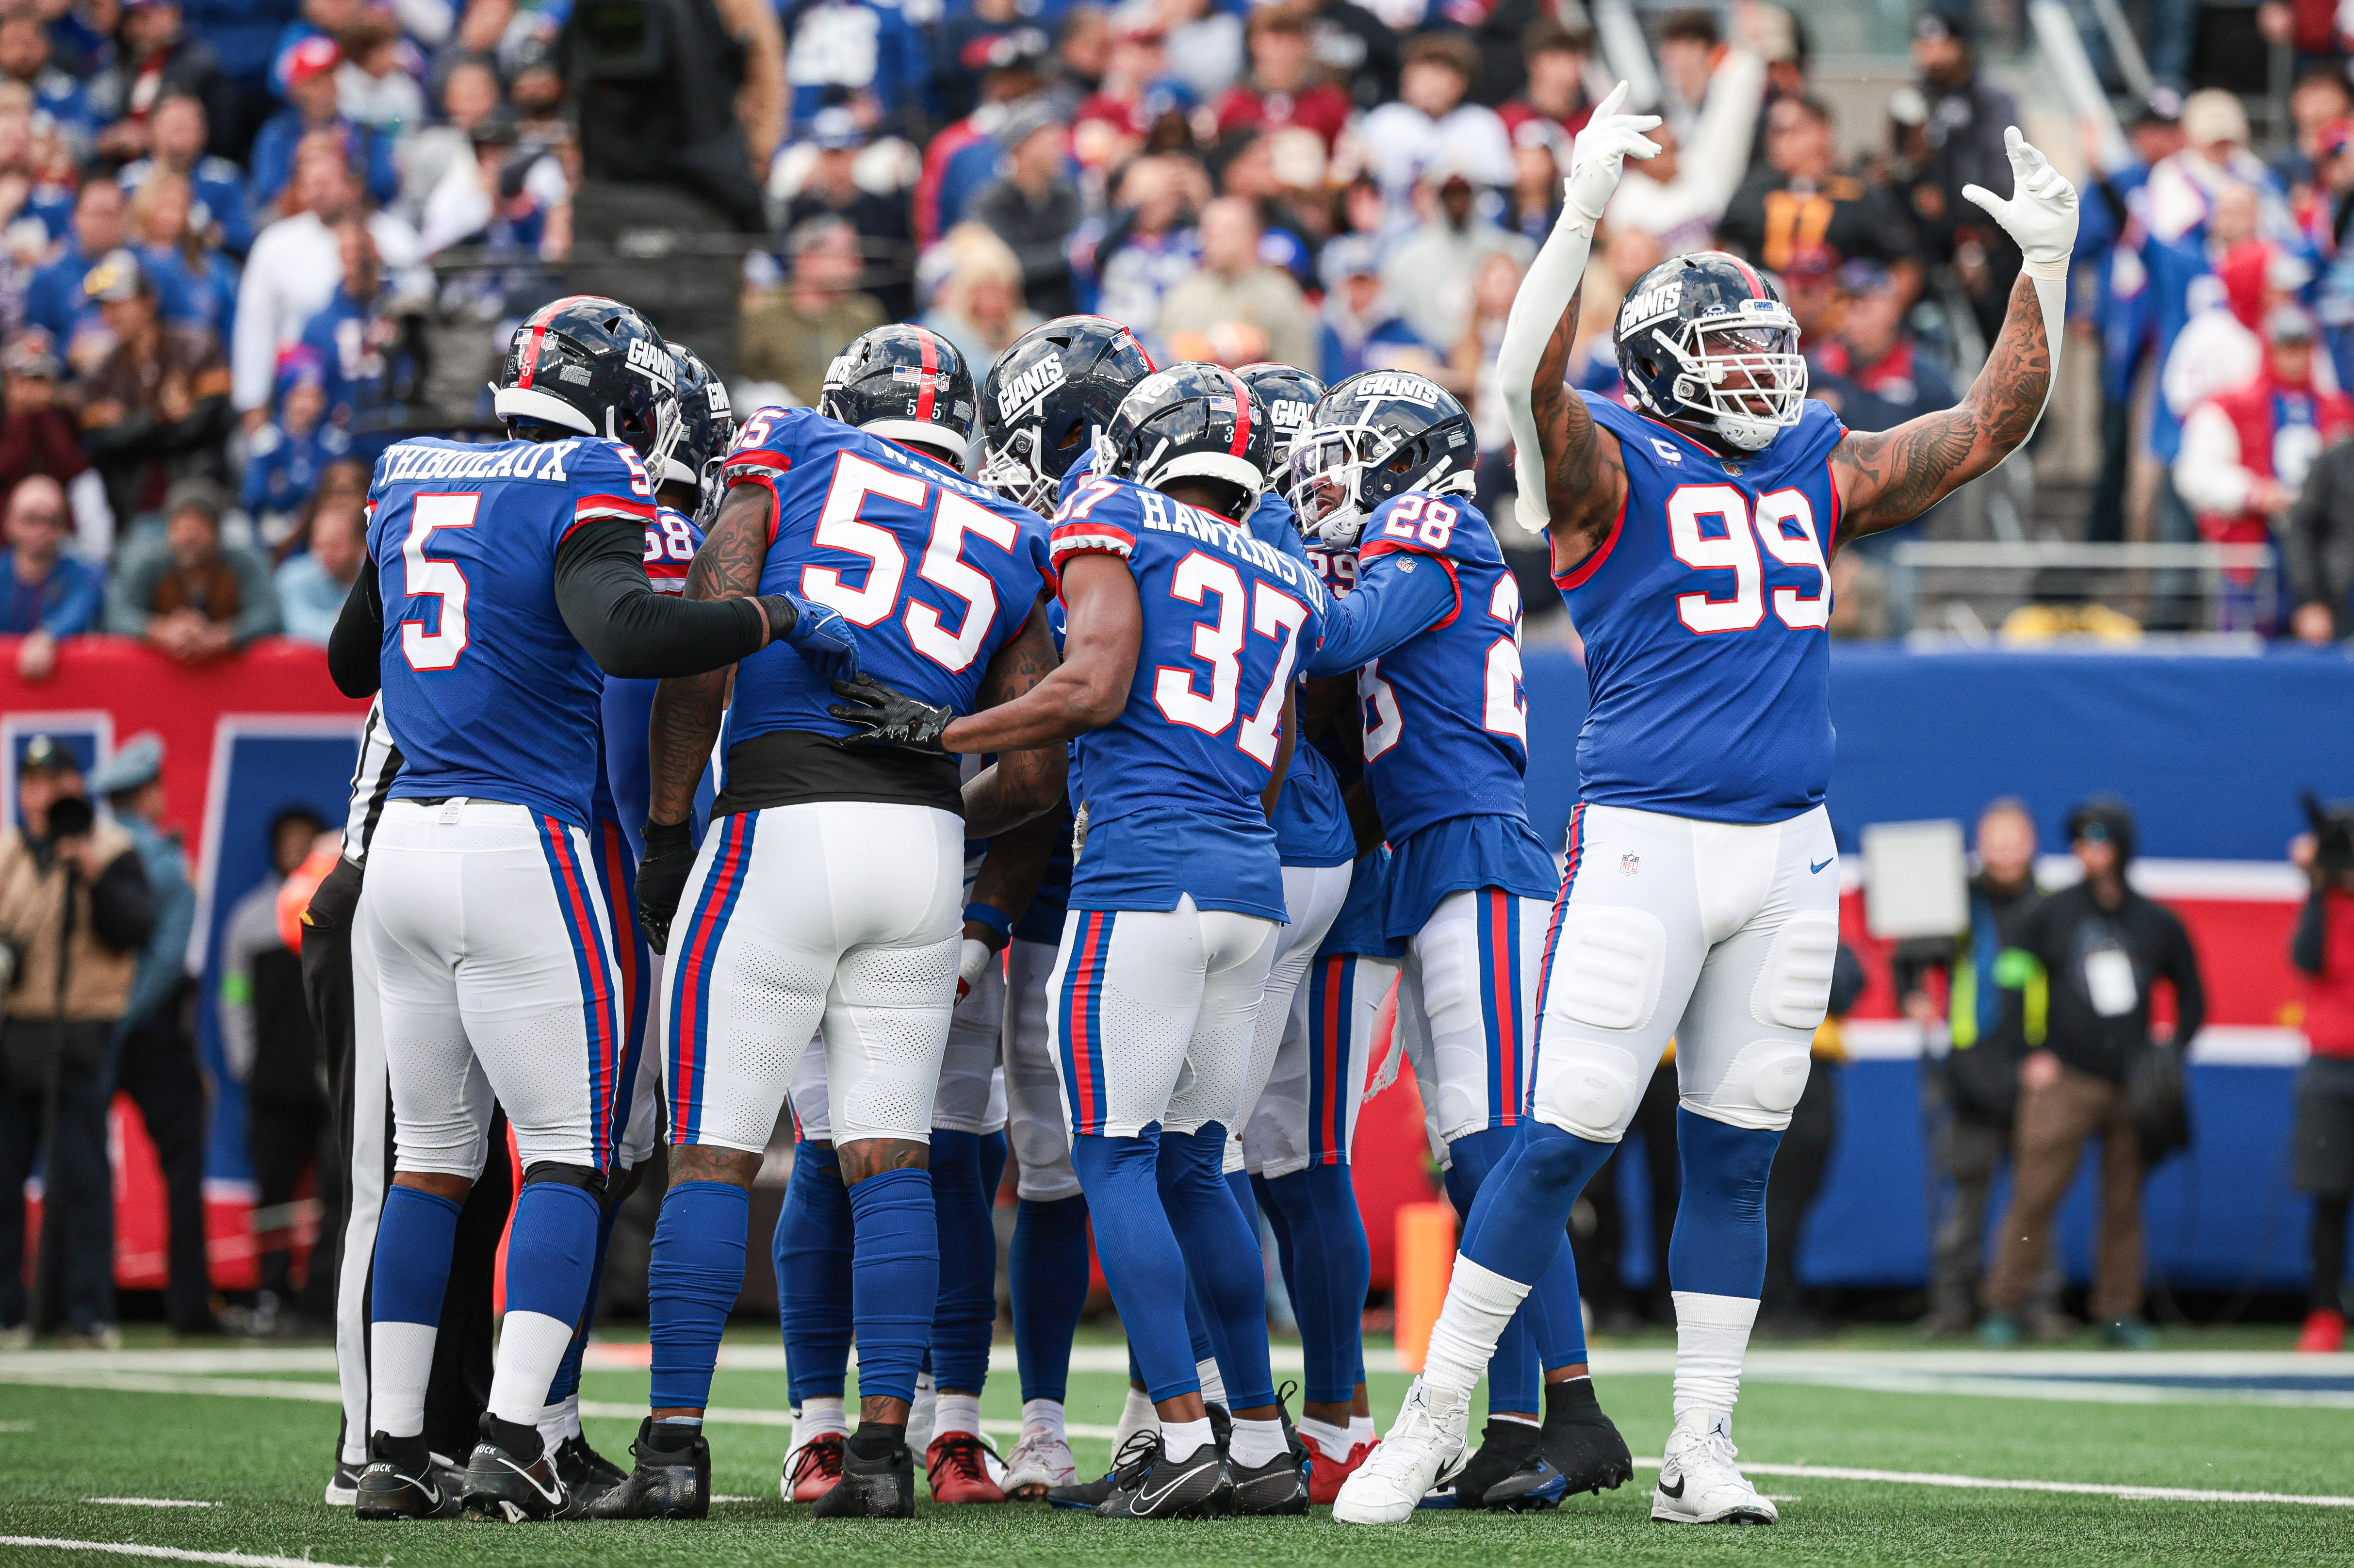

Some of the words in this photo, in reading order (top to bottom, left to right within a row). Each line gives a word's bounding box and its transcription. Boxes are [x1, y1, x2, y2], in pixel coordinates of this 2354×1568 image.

[1620, 282, 1683, 333] GIANTS
[542, 339, 555, 349] NFL
[627, 337, 676, 386] GIANTS
[522, 359, 532, 377] 5
[937, 381, 948, 390] NFL
[997, 352, 1064, 420] GIANTS
[1357, 376, 1440, 405] GIANTS
[706, 382, 731, 411] GIA
[1251, 413, 1261, 425] NFL
[380, 441, 582, 486] THIBODEAUX
[615, 446, 653, 497] 5
[1650, 437, 1682, 462] C
[1052, 479, 1123, 526] 37
[1382, 494, 1459, 551] 28
[1136, 490, 1297, 586] HAWKINS
[1665, 482, 1833, 635] 99
[401, 492, 482, 672] 5
[800, 449, 1020, 674] 55
[1398, 561, 1411, 572] NFL
[1152, 549, 1312, 772] 37
[1622, 861, 1635, 871] NFL
[369, 1463, 391, 1472] BUCK
[474, 1446, 496, 1455] BUCK
